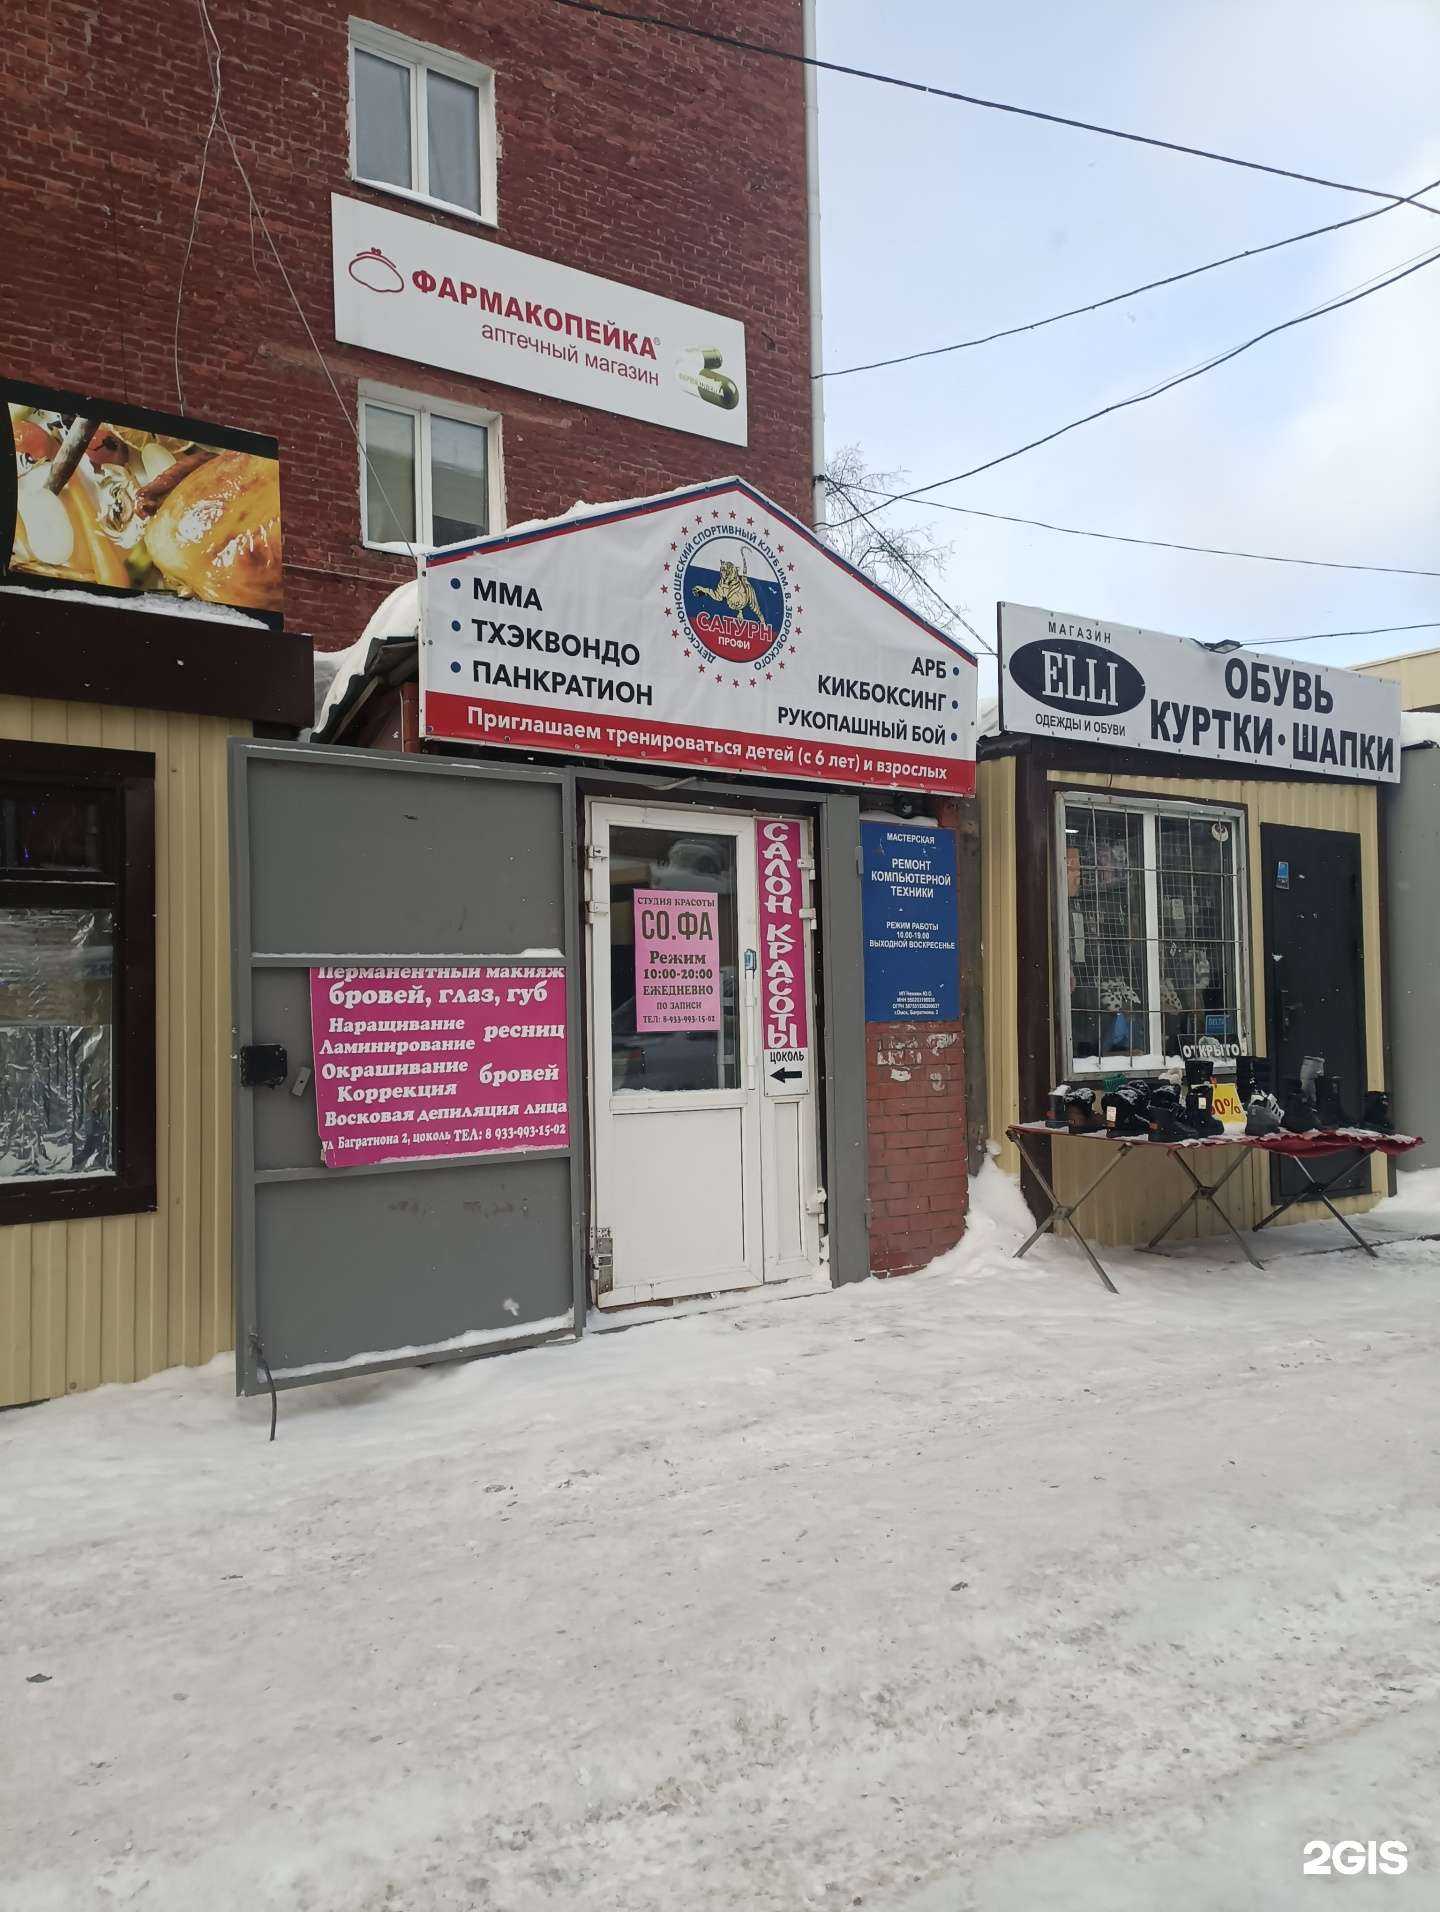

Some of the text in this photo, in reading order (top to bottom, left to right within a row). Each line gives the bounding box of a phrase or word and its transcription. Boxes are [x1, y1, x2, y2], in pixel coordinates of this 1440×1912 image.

[412, 269, 657, 360] ФАРМАКОПЕЙКА
[481, 321, 578, 364] аптечный
[585, 354, 659, 386] магазин
[692, 525, 757, 544] СПОРТИВНЫЙ
[758, 540, 779, 566] КЛУБ
[778, 567, 789, 590] ИМ.
[473, 577, 542, 611] ММА
[673, 543, 716, 664] ДЕТСКО-ЮНОШЕСКИЙ
[697, 611, 773, 642] САТУРН
[754, 606, 792, 670] ЗБОРОВСКОГО
[1048, 621, 1112, 644] МАГАЗИН
[472, 618, 640, 666] ТХЭКВОНДО
[718, 637, 750, 650] ПРОФИ
[911, 656, 947, 679] АРБ
[1041, 650, 1118, 706] ELLI
[473, 660, 653, 706] ПАНКРАТИОН
[817, 675, 947, 712] КИКБОКСИНГ
[1225, 658, 1334, 714] ОБУВЬ
[778, 706, 946, 745] РУКОПАШНЫЙ БОЙ
[1035, 713, 1126, 737] ОДЕЖДЫ И ОБУВИ
[1150, 698, 1393, 773] КУРТКИ ШАПКИ
[468, 706, 947, 780] Приглашаем тренироваться детей (с 6 лет) и взрослых
[887, 833, 935, 845] МАСТЕРСКАЯ
[892, 858, 931, 871] РЕМОНТ
[871, 871, 951, 885] КОМПЬЮТЕРНОЙ
[637, 897, 714, 907] СТУДИЯ КРАСОТЫ
[891, 886, 934, 898] ТЕХНИКИ
[641, 910, 713, 940] СО.ФА
[762, 823, 798, 1048] САЛОН КРАСОТЫ
[886, 921, 938, 930] РЕЖИМ РАБОТЫ
[869, 939, 955, 949] ВЫХОДНОЙ ВОСКРЕСЕНЬЕ
[649, 951, 706, 964] Режим
[485, 967, 565, 978] макияж
[644, 969, 713, 979] 10:00-20:00
[329, 980, 548, 1008] бровей, глаз, губ
[643, 985, 713, 996] ЕЖЕДНЕВНО
[656, 1001, 702, 1010] ПО ЗАПИСИ
[329, 1018, 465, 1035] Наращивание
[643, 1015, 660, 1023] ТЕЛ:
[483, 1023, 565, 1042] ресниц
[319, 1038, 475, 1055] Ламинирование
[770, 1051, 804, 1062] ЦОКОЛЬ
[1183, 1043, 1240, 1058] ОТКРЫТО
[322, 1061, 469, 1082] Окрашивание
[479, 1062, 559, 1086] бровей
[337, 1082, 457, 1104] Коррекция
[325, 1102, 568, 1127] Восковая депиляция лица
[322, 1124, 566, 1152] ул Багратиона 2, цоколь ТЕЛ: 8 933-993-15-02
